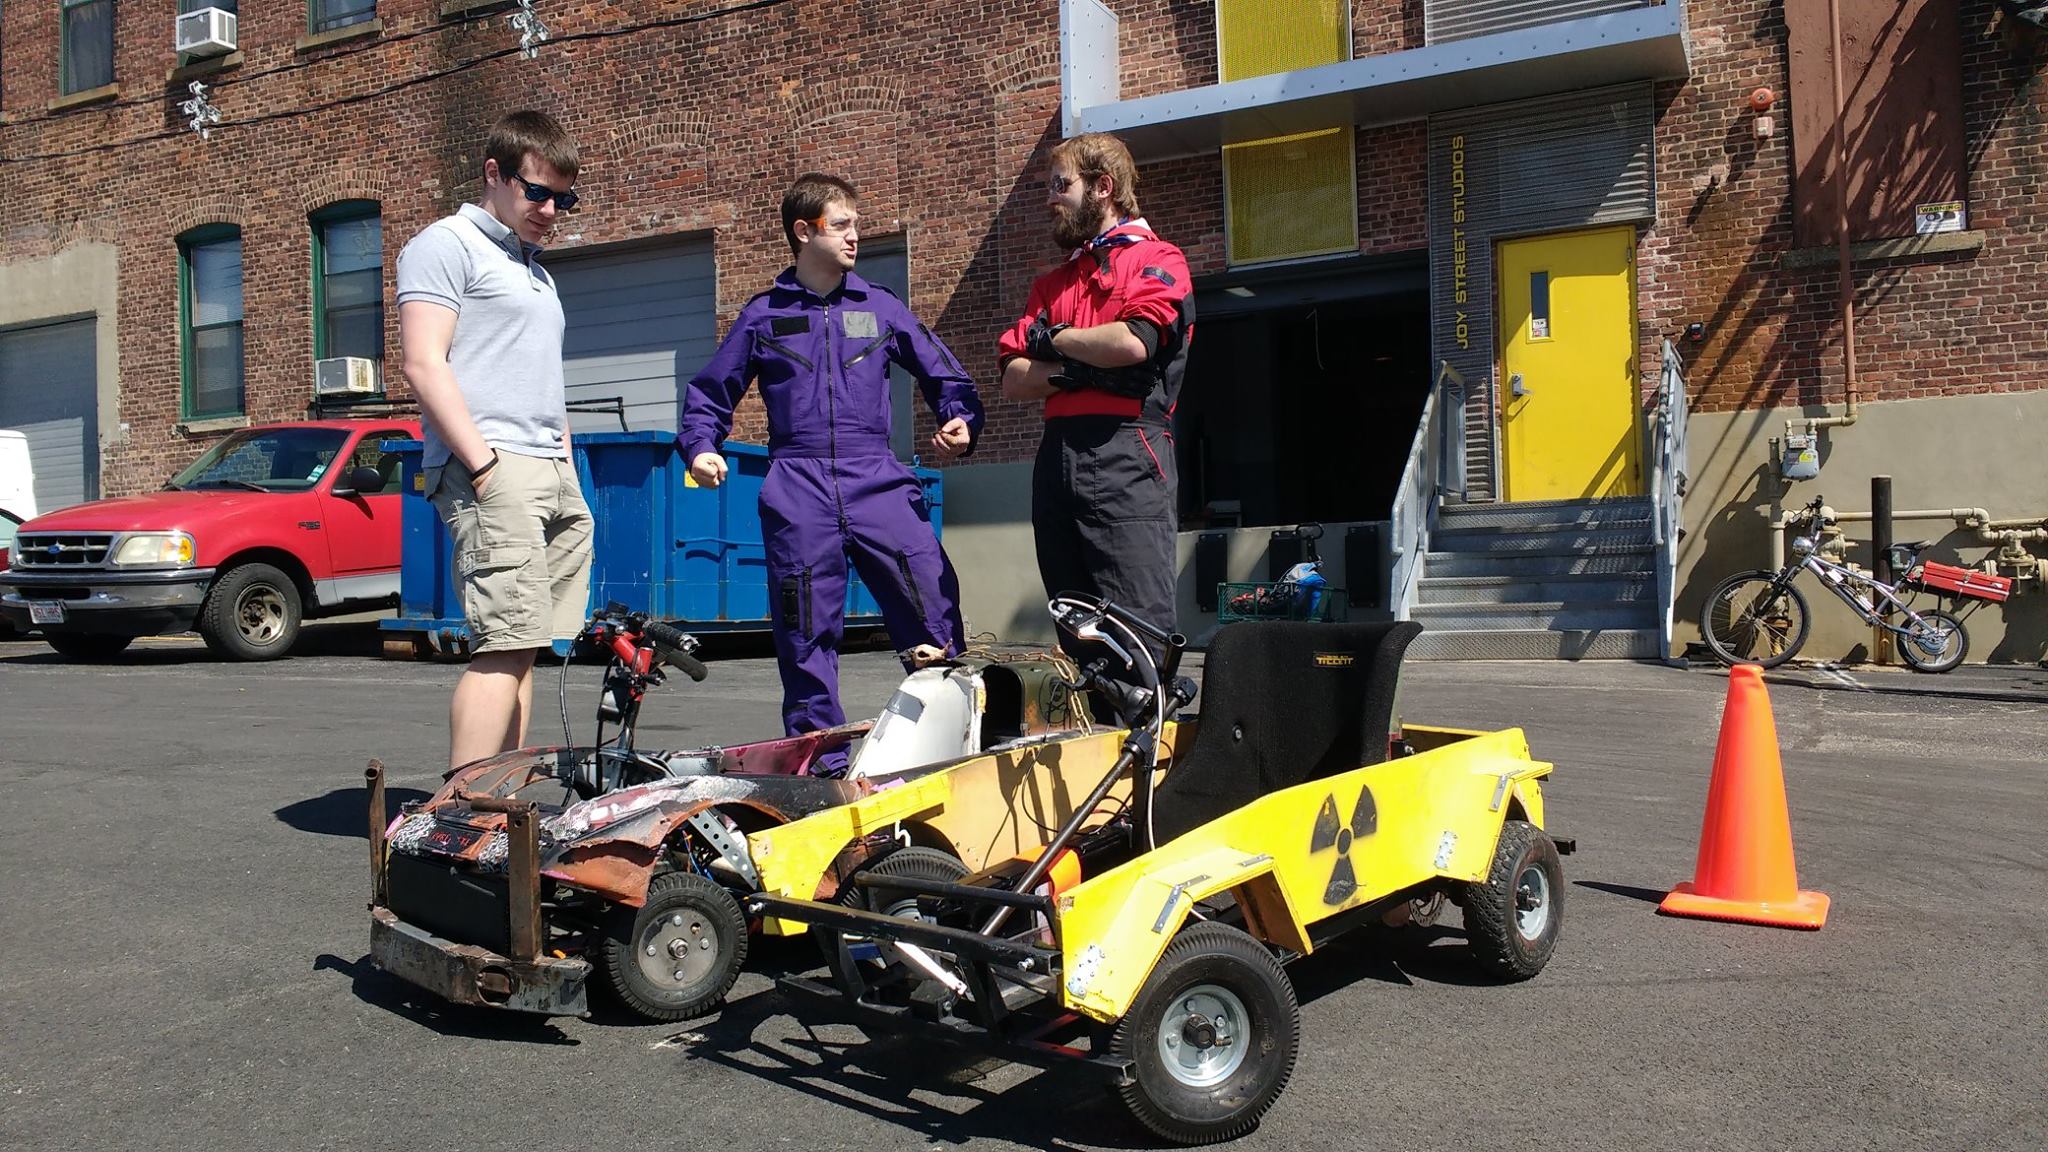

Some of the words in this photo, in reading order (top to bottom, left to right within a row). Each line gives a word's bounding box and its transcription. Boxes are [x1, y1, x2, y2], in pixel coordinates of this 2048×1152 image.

[1452, 135, 1465, 224] STUDIOS
[1920, 204, 1962, 213] WARNING
[1453, 227, 1467, 304] STREET
[1454, 311, 1469, 350] JOY
